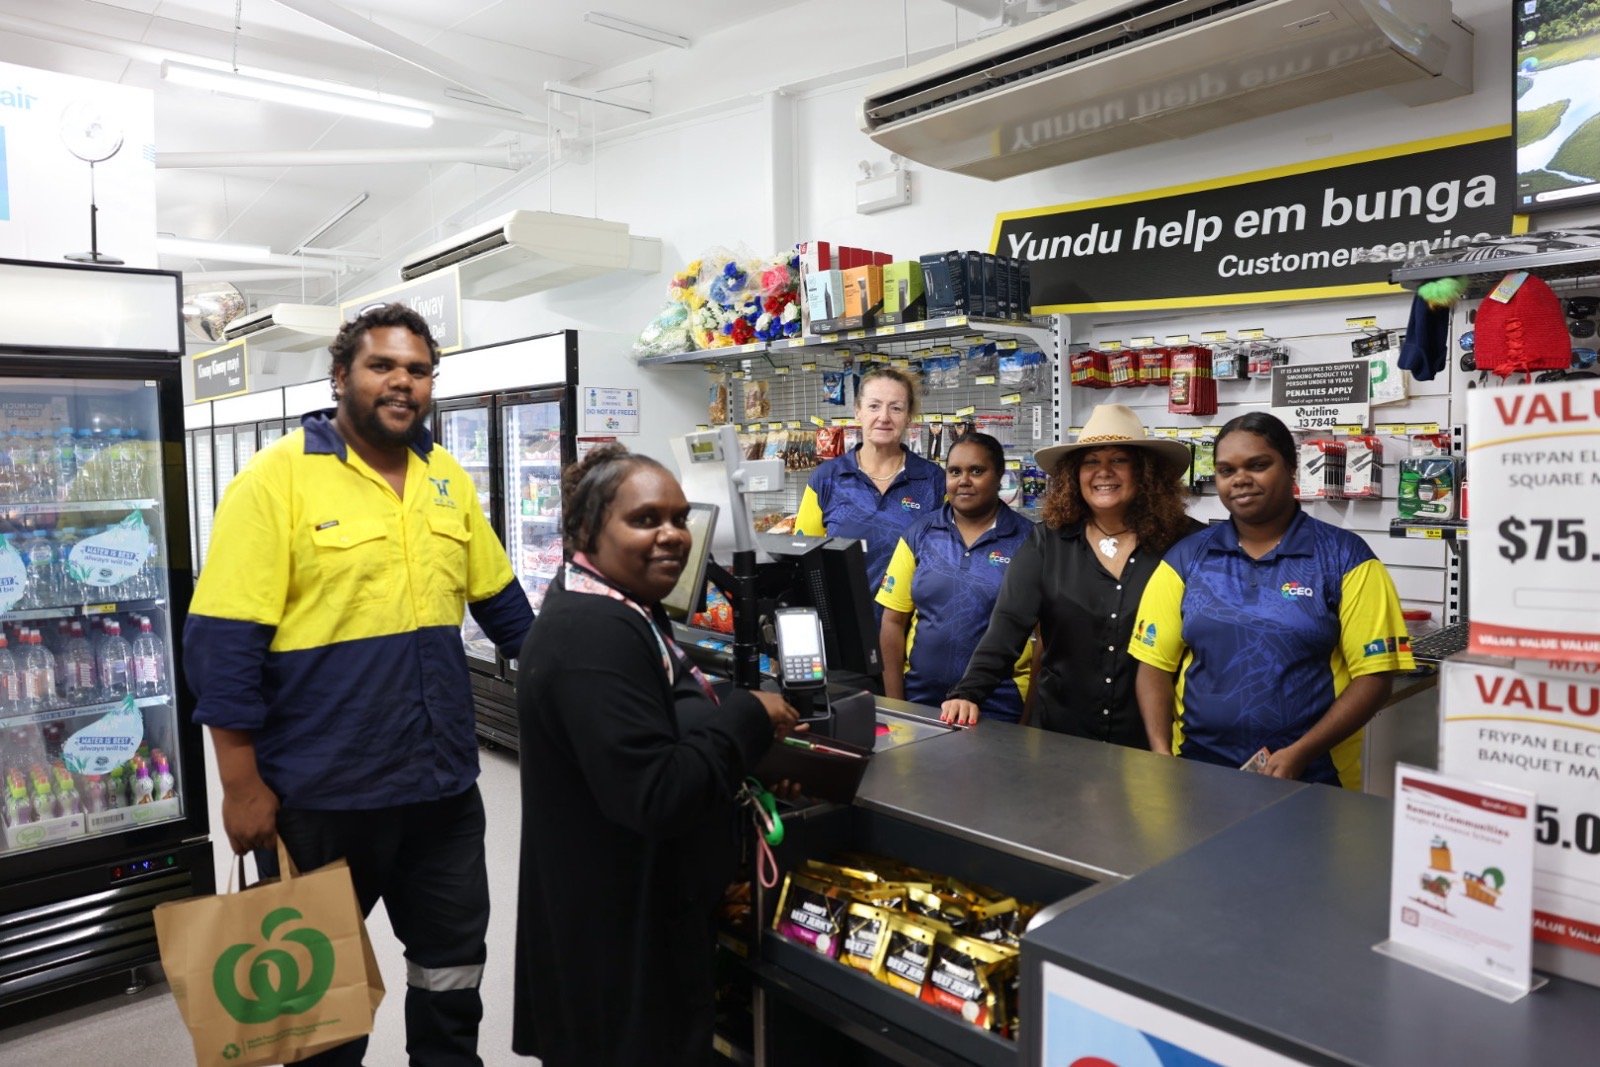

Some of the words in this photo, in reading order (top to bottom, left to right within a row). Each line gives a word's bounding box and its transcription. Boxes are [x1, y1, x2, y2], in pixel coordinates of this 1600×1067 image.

[1007, 224, 1123, 261] Yundu
[1132, 209, 1223, 255] help
[1233, 202, 1307, 239] em
[1320, 174, 1497, 227] bunga
[1218, 246, 1360, 279] Customer
[1285, 388, 1326, 398] PENALTIES
[1327, 386, 1353, 395] APPLY
[1295, 407, 1339, 417] Quitline
[1311, 417, 1337, 427] 7848
[1502, 449, 1573, 466] FRYPAN
[1509, 472, 1584, 491] SQUARE
[906, 501, 921, 510] CEQ
[995, 555, 1011, 564] CEQ
[1289, 587, 1314, 598] CEQ
[1478, 635, 1517, 647] VALUE
[1519, 637, 1558, 650] VALUE
[1560, 639, 1600, 653] VALUE
[1479, 728, 1547, 750] FRYPAN
[1553, 739, 1600, 758] ELEC
[1478, 748, 1562, 773] BANQUET
[1533, 918, 1566, 935] ALUE
